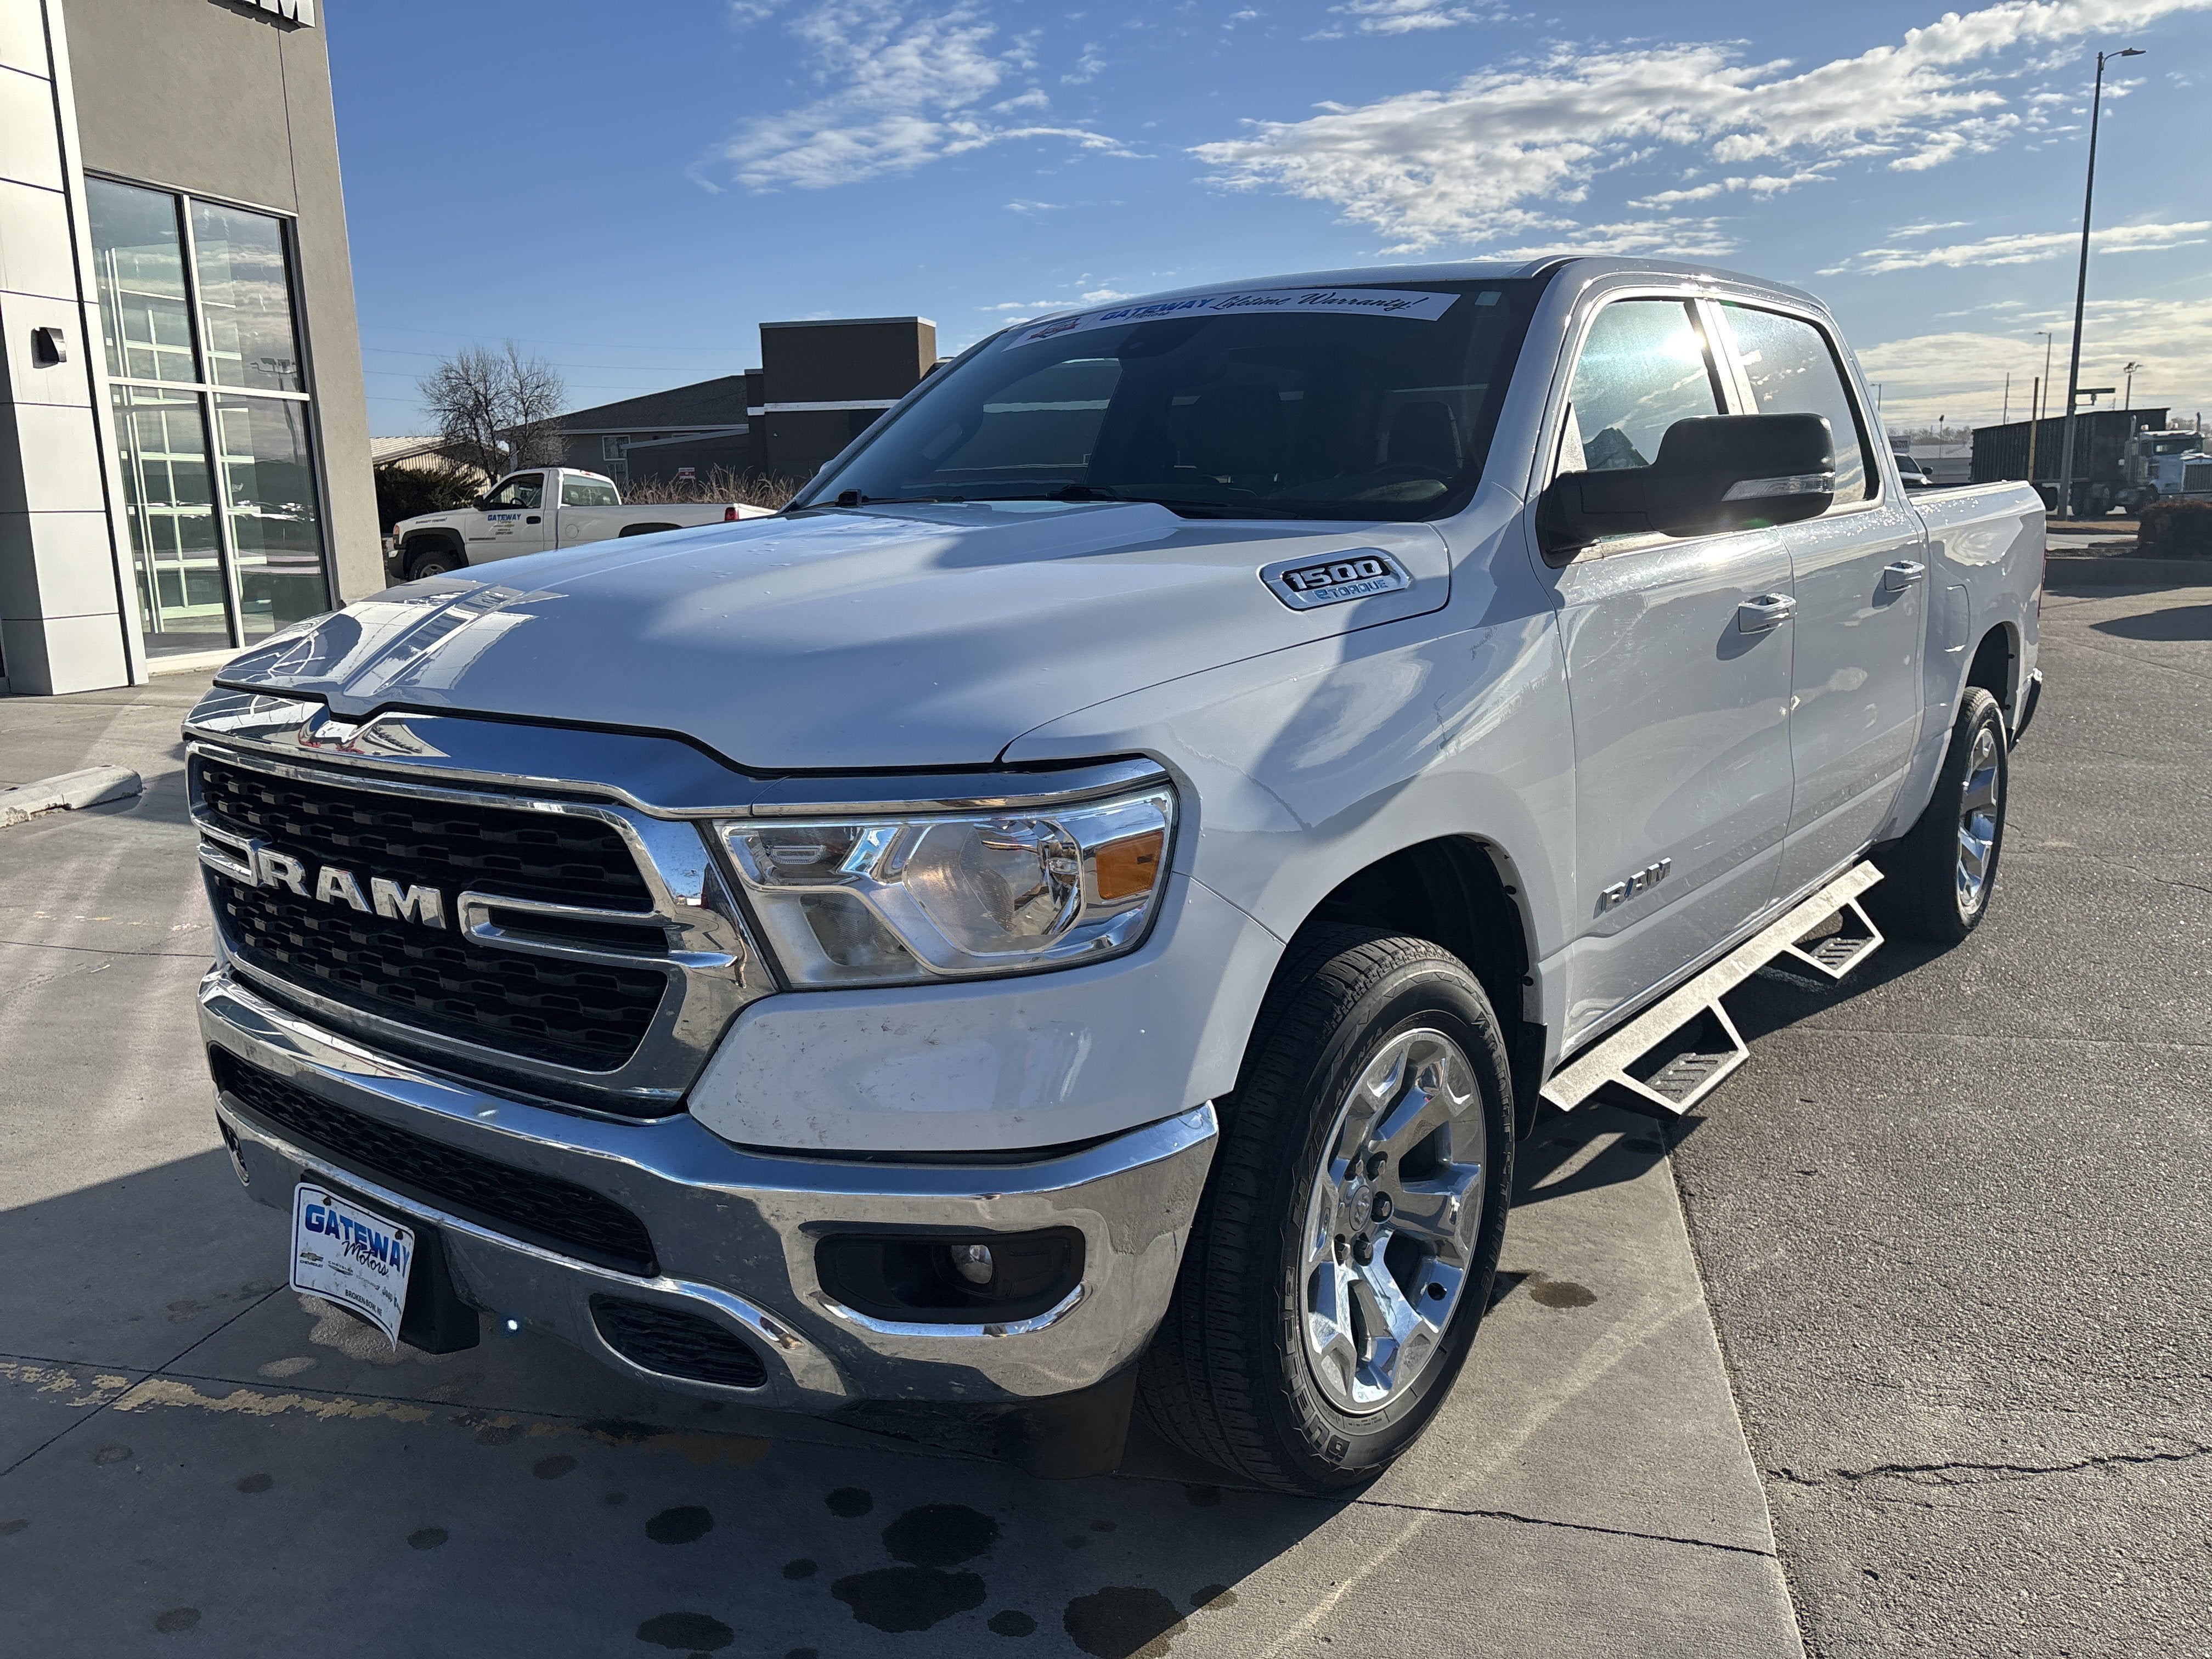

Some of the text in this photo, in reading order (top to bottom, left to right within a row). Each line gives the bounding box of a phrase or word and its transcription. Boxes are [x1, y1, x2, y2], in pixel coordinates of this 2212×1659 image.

[1100, 292, 1430, 321] GATEWAY Lifetime Warranty!
[1286, 560, 1383, 590] 1500
[258, 847, 447, 930] RAM
[1596, 857, 1672, 916] RAM
[305, 1204, 410, 1278] GATEWAY
[328, 1261, 354, 1273] CHRYSLER
[341, 1240, 389, 1276] Motors
[345, 1289, 365, 1305] BROKEN
